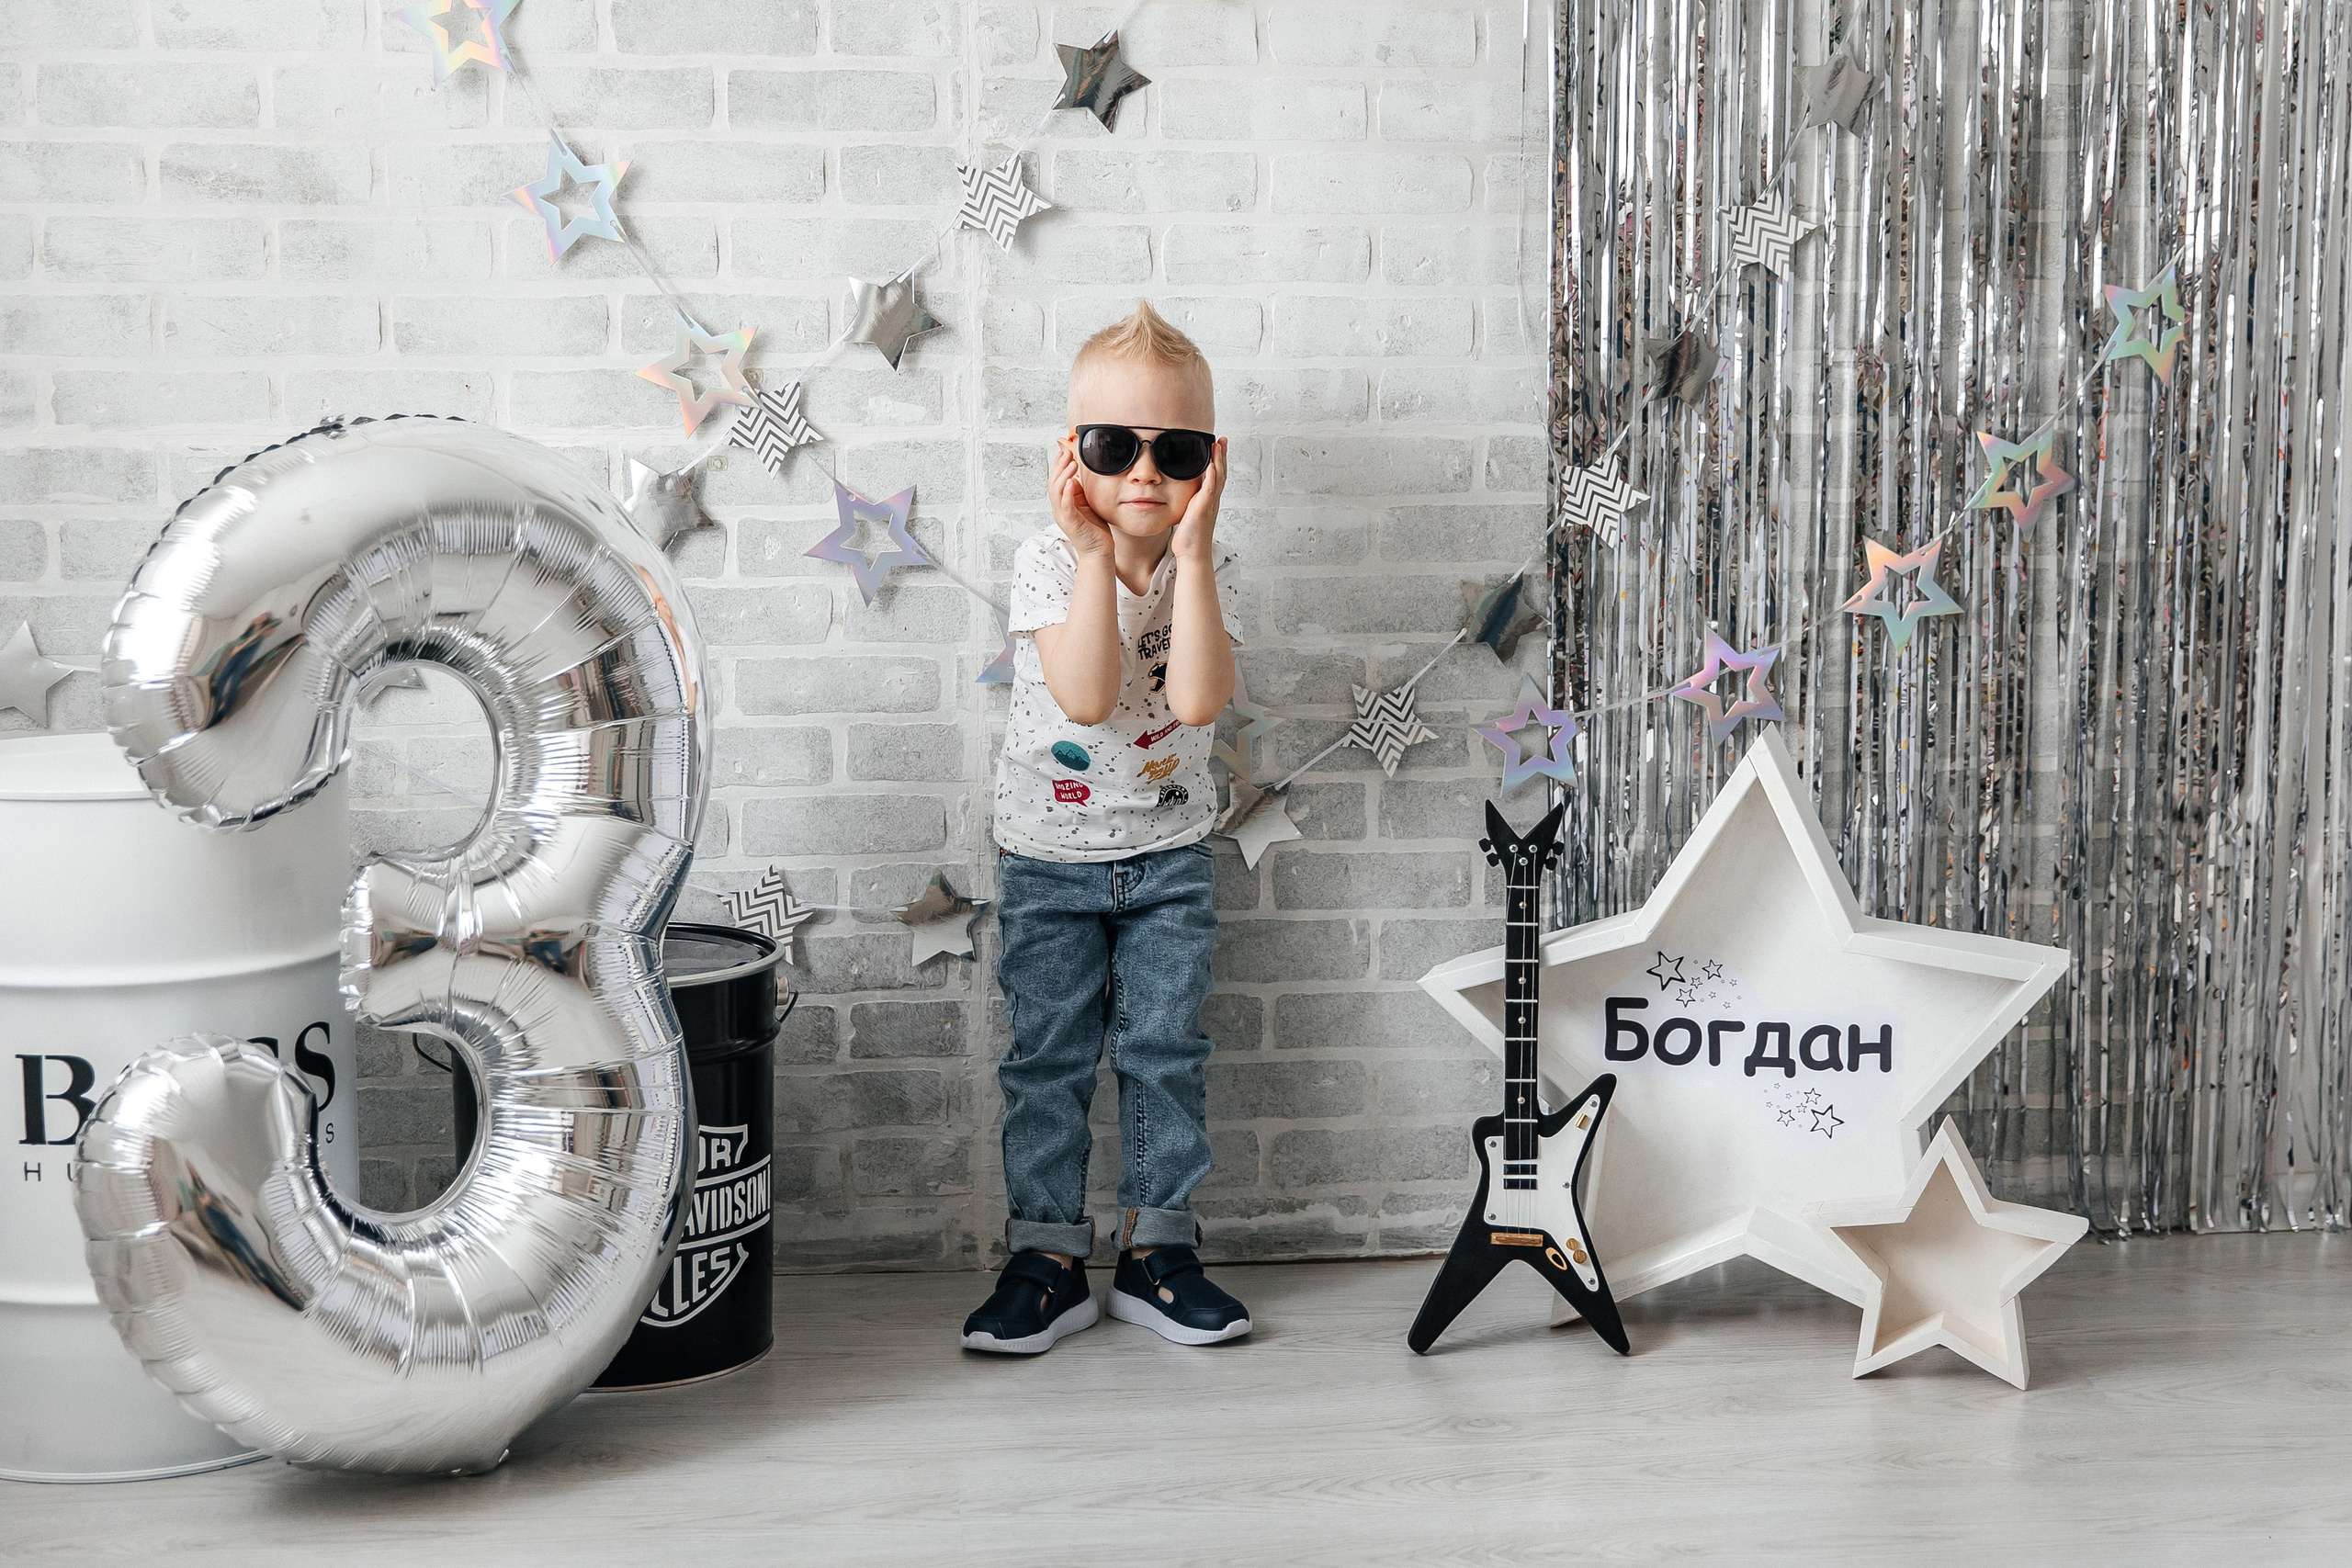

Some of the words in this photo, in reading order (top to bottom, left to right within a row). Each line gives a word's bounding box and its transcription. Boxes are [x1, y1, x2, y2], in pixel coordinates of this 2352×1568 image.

[1059, 791, 1082, 800] WORLD
[1604, 997, 1893, 1078] Богдан
[15, 1021, 336, 1145] BS
[681, 1168, 767, 1236] AVIDSON
